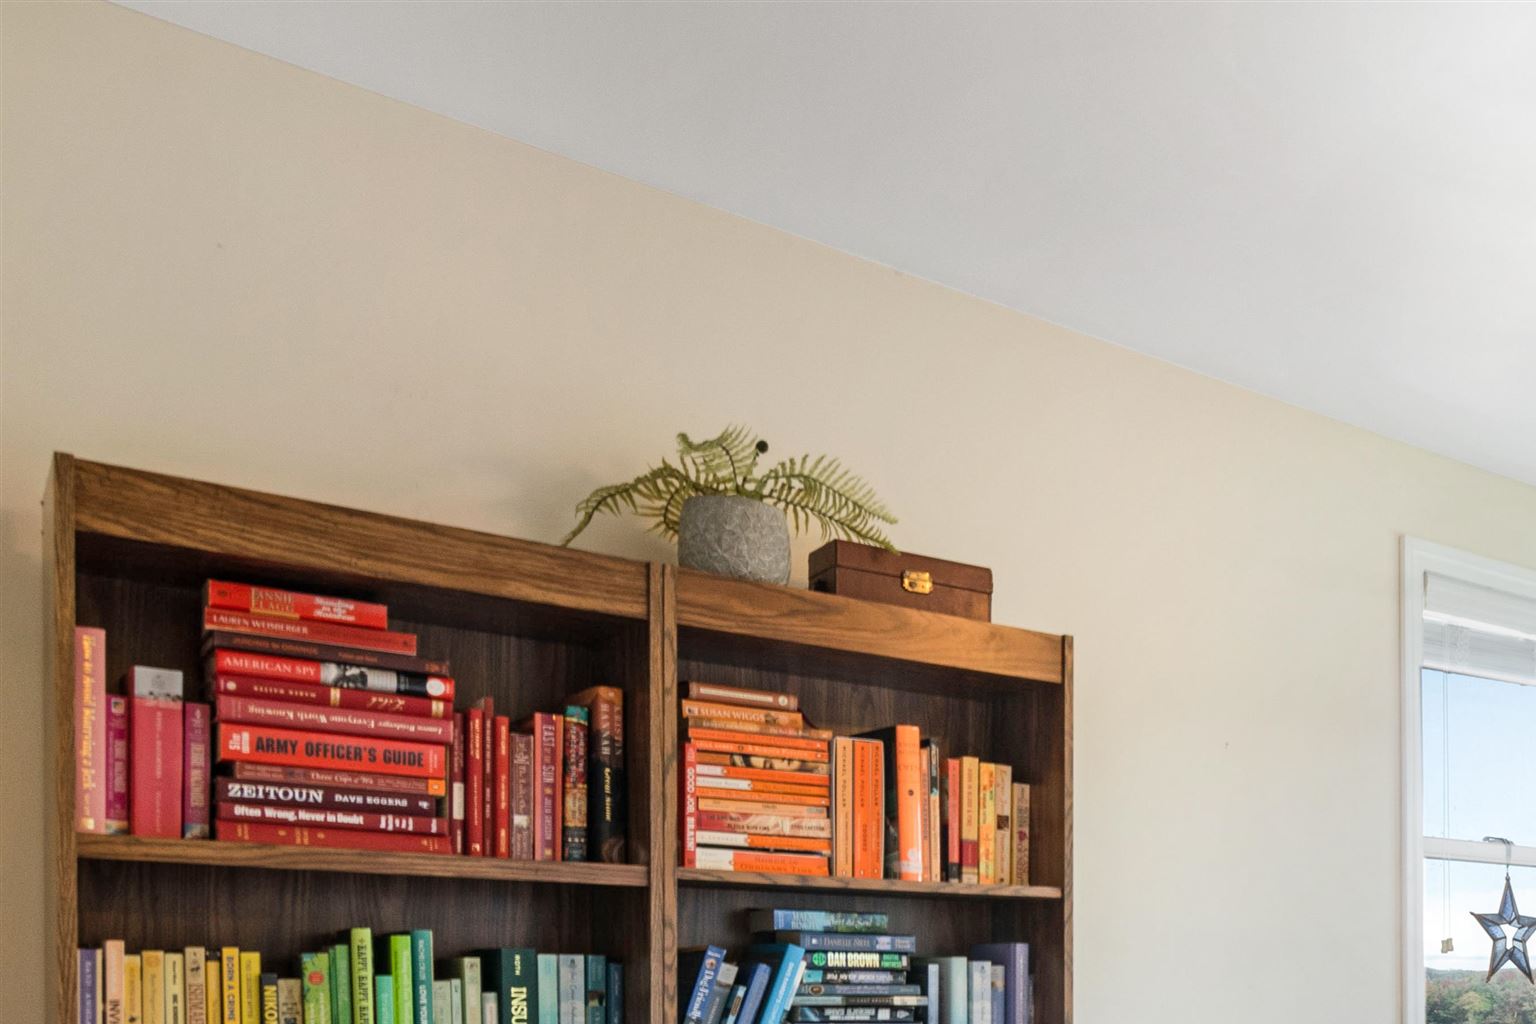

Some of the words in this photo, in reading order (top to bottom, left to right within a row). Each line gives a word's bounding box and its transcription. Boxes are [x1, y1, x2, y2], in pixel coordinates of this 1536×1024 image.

[213, 614, 250, 627] LAUREN
[223, 656, 293, 674] AMERICAN
[295, 663, 318, 677] SPY
[248, 704, 294, 721] Knowing
[297, 710, 327, 725] Worth
[701, 706, 732, 718] SUSAN
[543, 724, 555, 747] EAST
[600, 703, 611, 755] HANNAH
[255, 736, 298, 756] ARMY
[304, 740, 377, 763] OFFICER'S
[383, 749, 424, 768] GUIDE
[686, 766, 696, 794] GOOD
[227, 782, 324, 803] ZEITOUN
[334, 793, 364, 805] DAVE
[366, 795, 408, 807] EGGERS
[234, 804, 262, 817] Often
[298, 809, 326, 822] Never
[326, 811, 337, 823] in
[337, 813, 364, 825] Doubt
[686, 815, 696, 852] BRAIN!
[827, 951, 847, 968] DAN
[847, 952, 880, 968] BROWN
